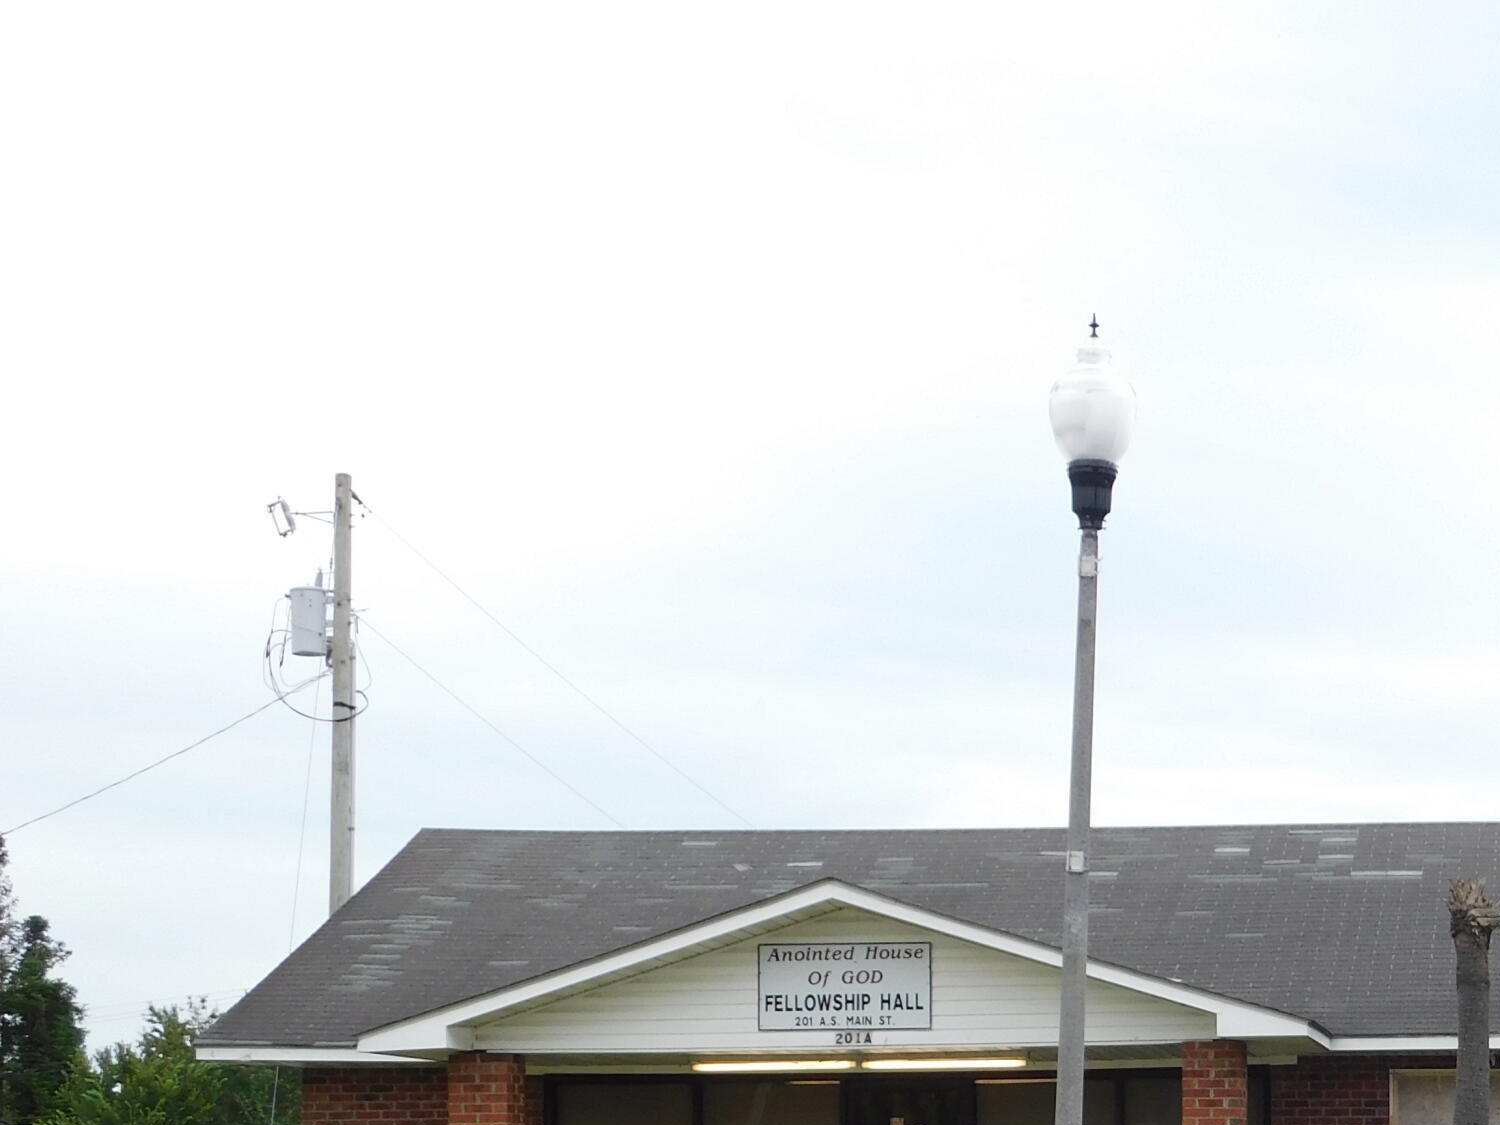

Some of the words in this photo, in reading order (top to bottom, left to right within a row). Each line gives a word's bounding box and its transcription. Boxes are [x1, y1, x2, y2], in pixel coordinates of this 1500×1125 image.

[768, 947, 854, 962] Anointed
[865, 946, 924, 960] House
[808, 971, 831, 987] Of
[842, 970, 883, 984] GOD
[765, 994, 871, 1011] FELLOWSHIP
[881, 993, 924, 1010] HALL
[795, 1017, 813, 1026] 201
[846, 1016, 872, 1025] MAIN
[835, 1033, 872, 1044] 201A
